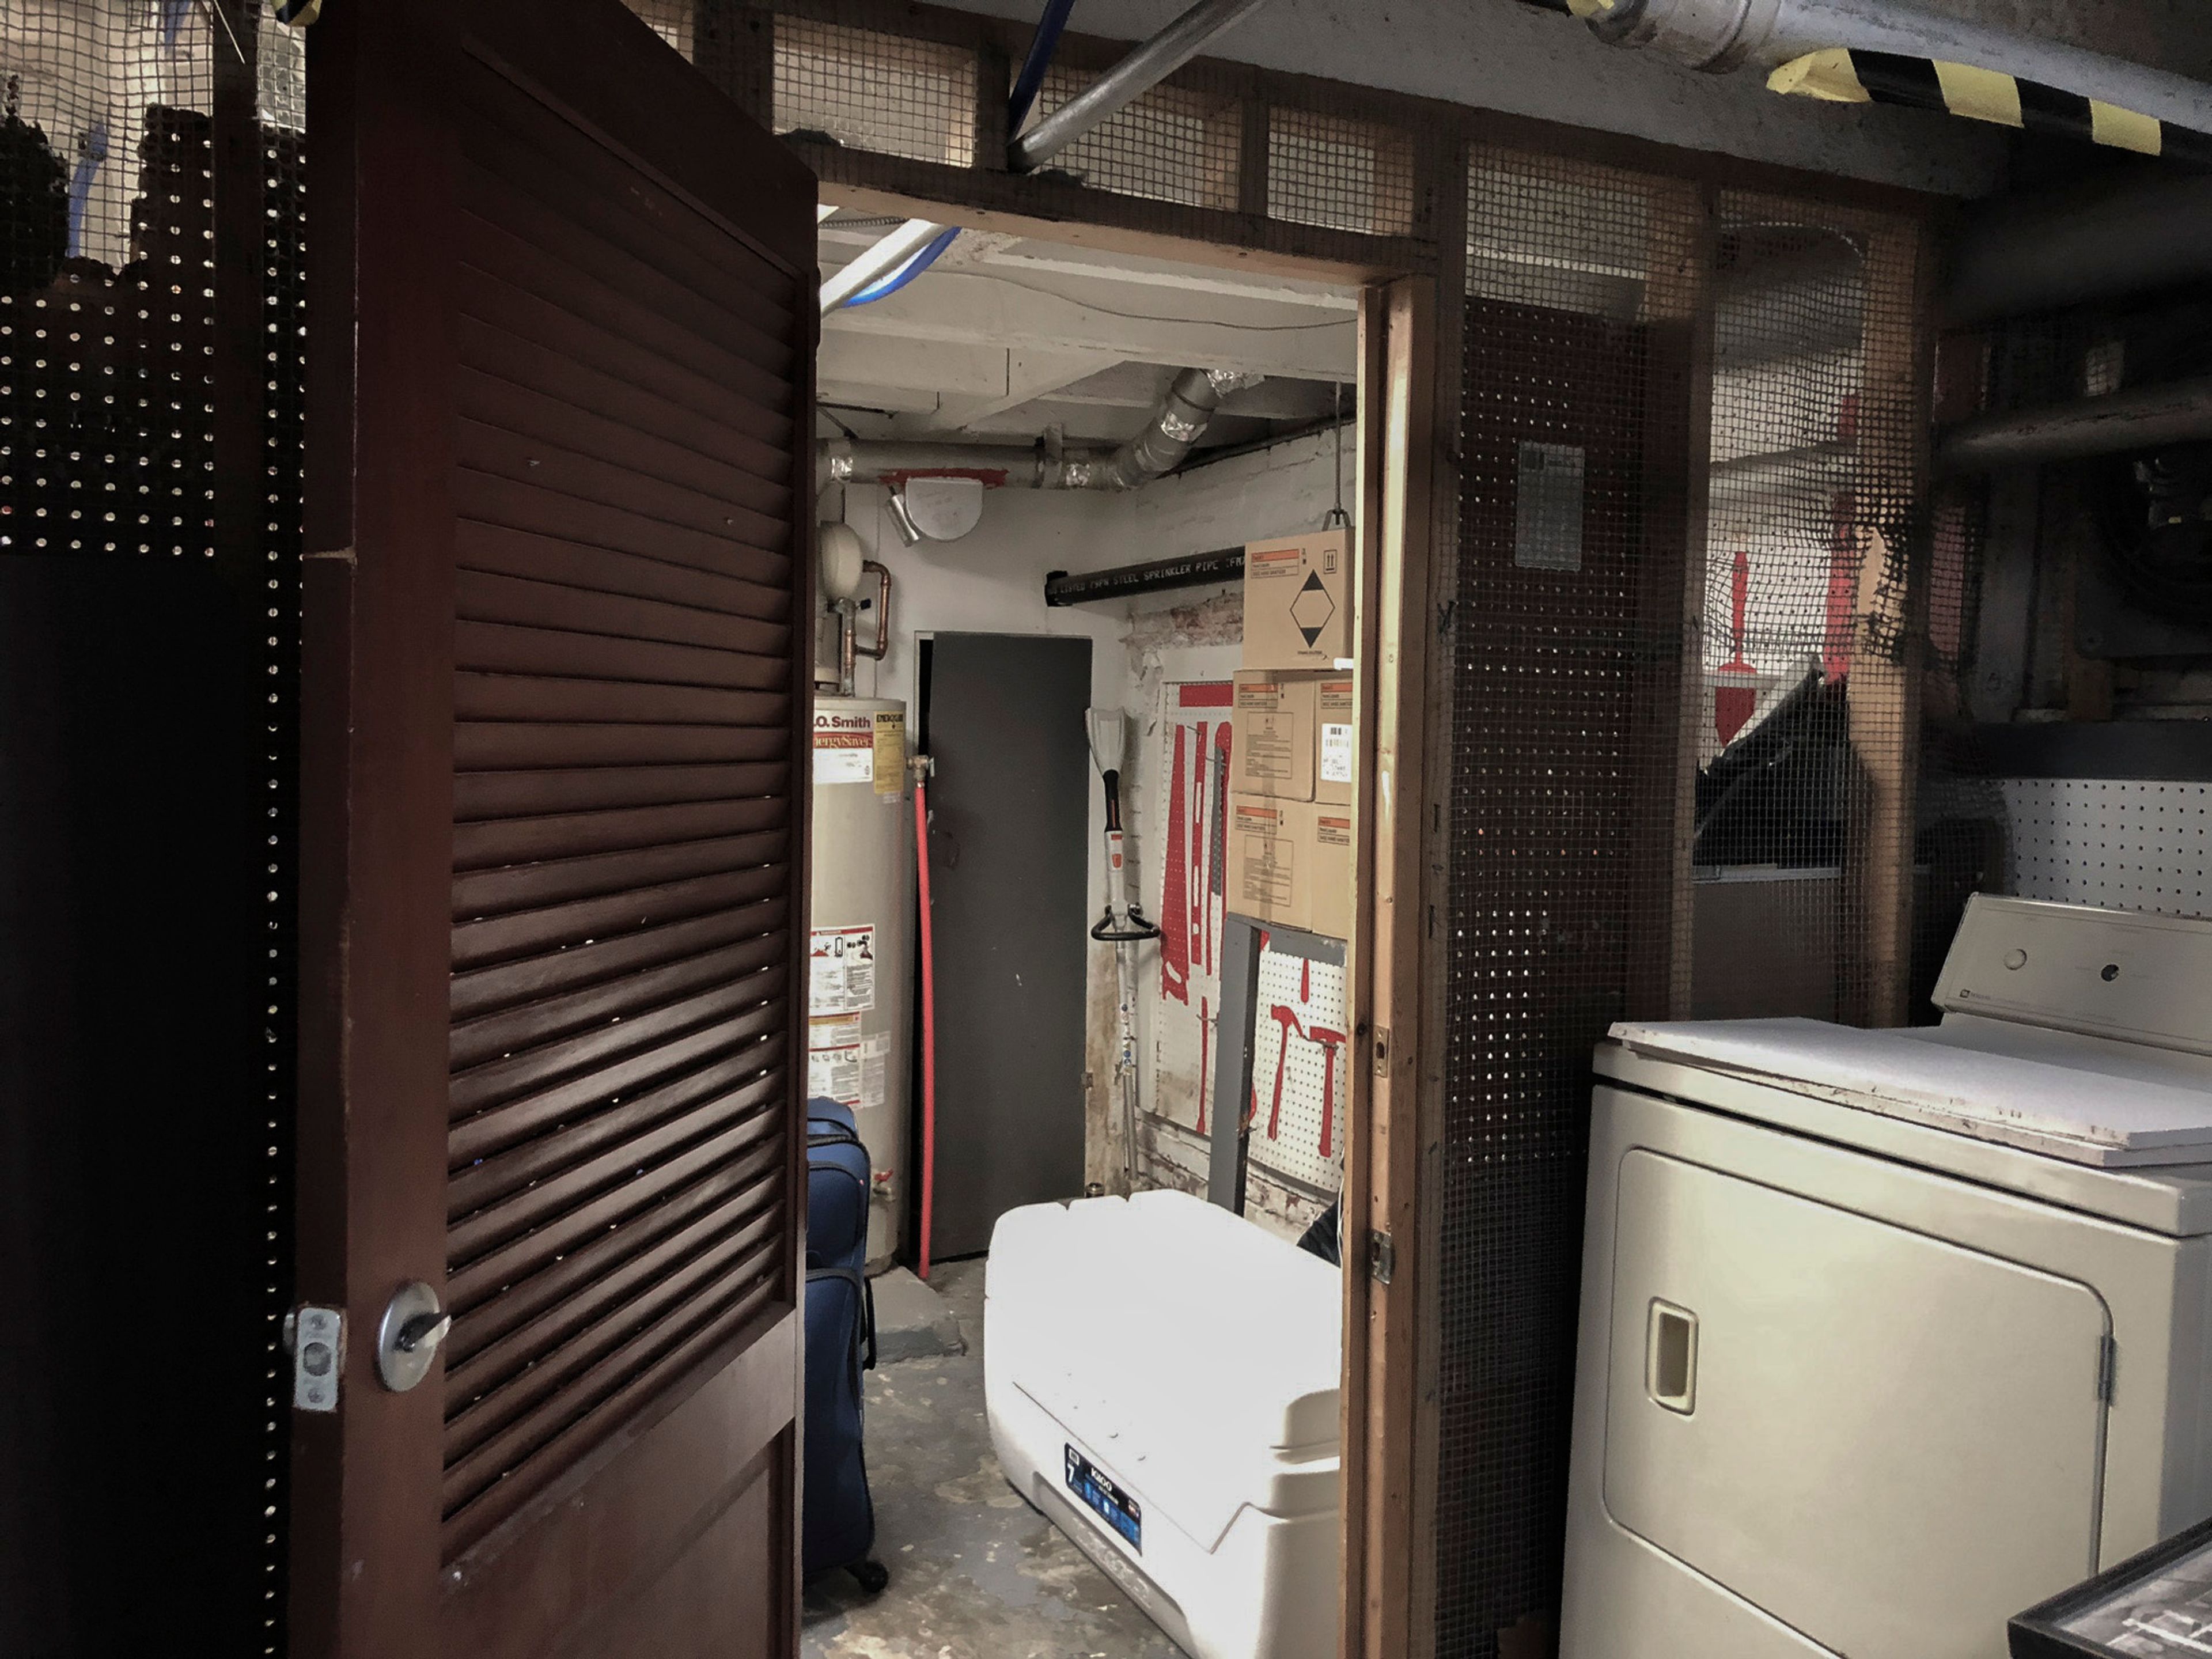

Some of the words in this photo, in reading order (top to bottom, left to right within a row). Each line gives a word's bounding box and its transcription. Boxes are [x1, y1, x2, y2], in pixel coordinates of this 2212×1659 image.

[1144, 563, 1191, 581] SPRINKLER
[1195, 560, 1218, 572] PIPE
[832, 715, 870, 728] Smith
